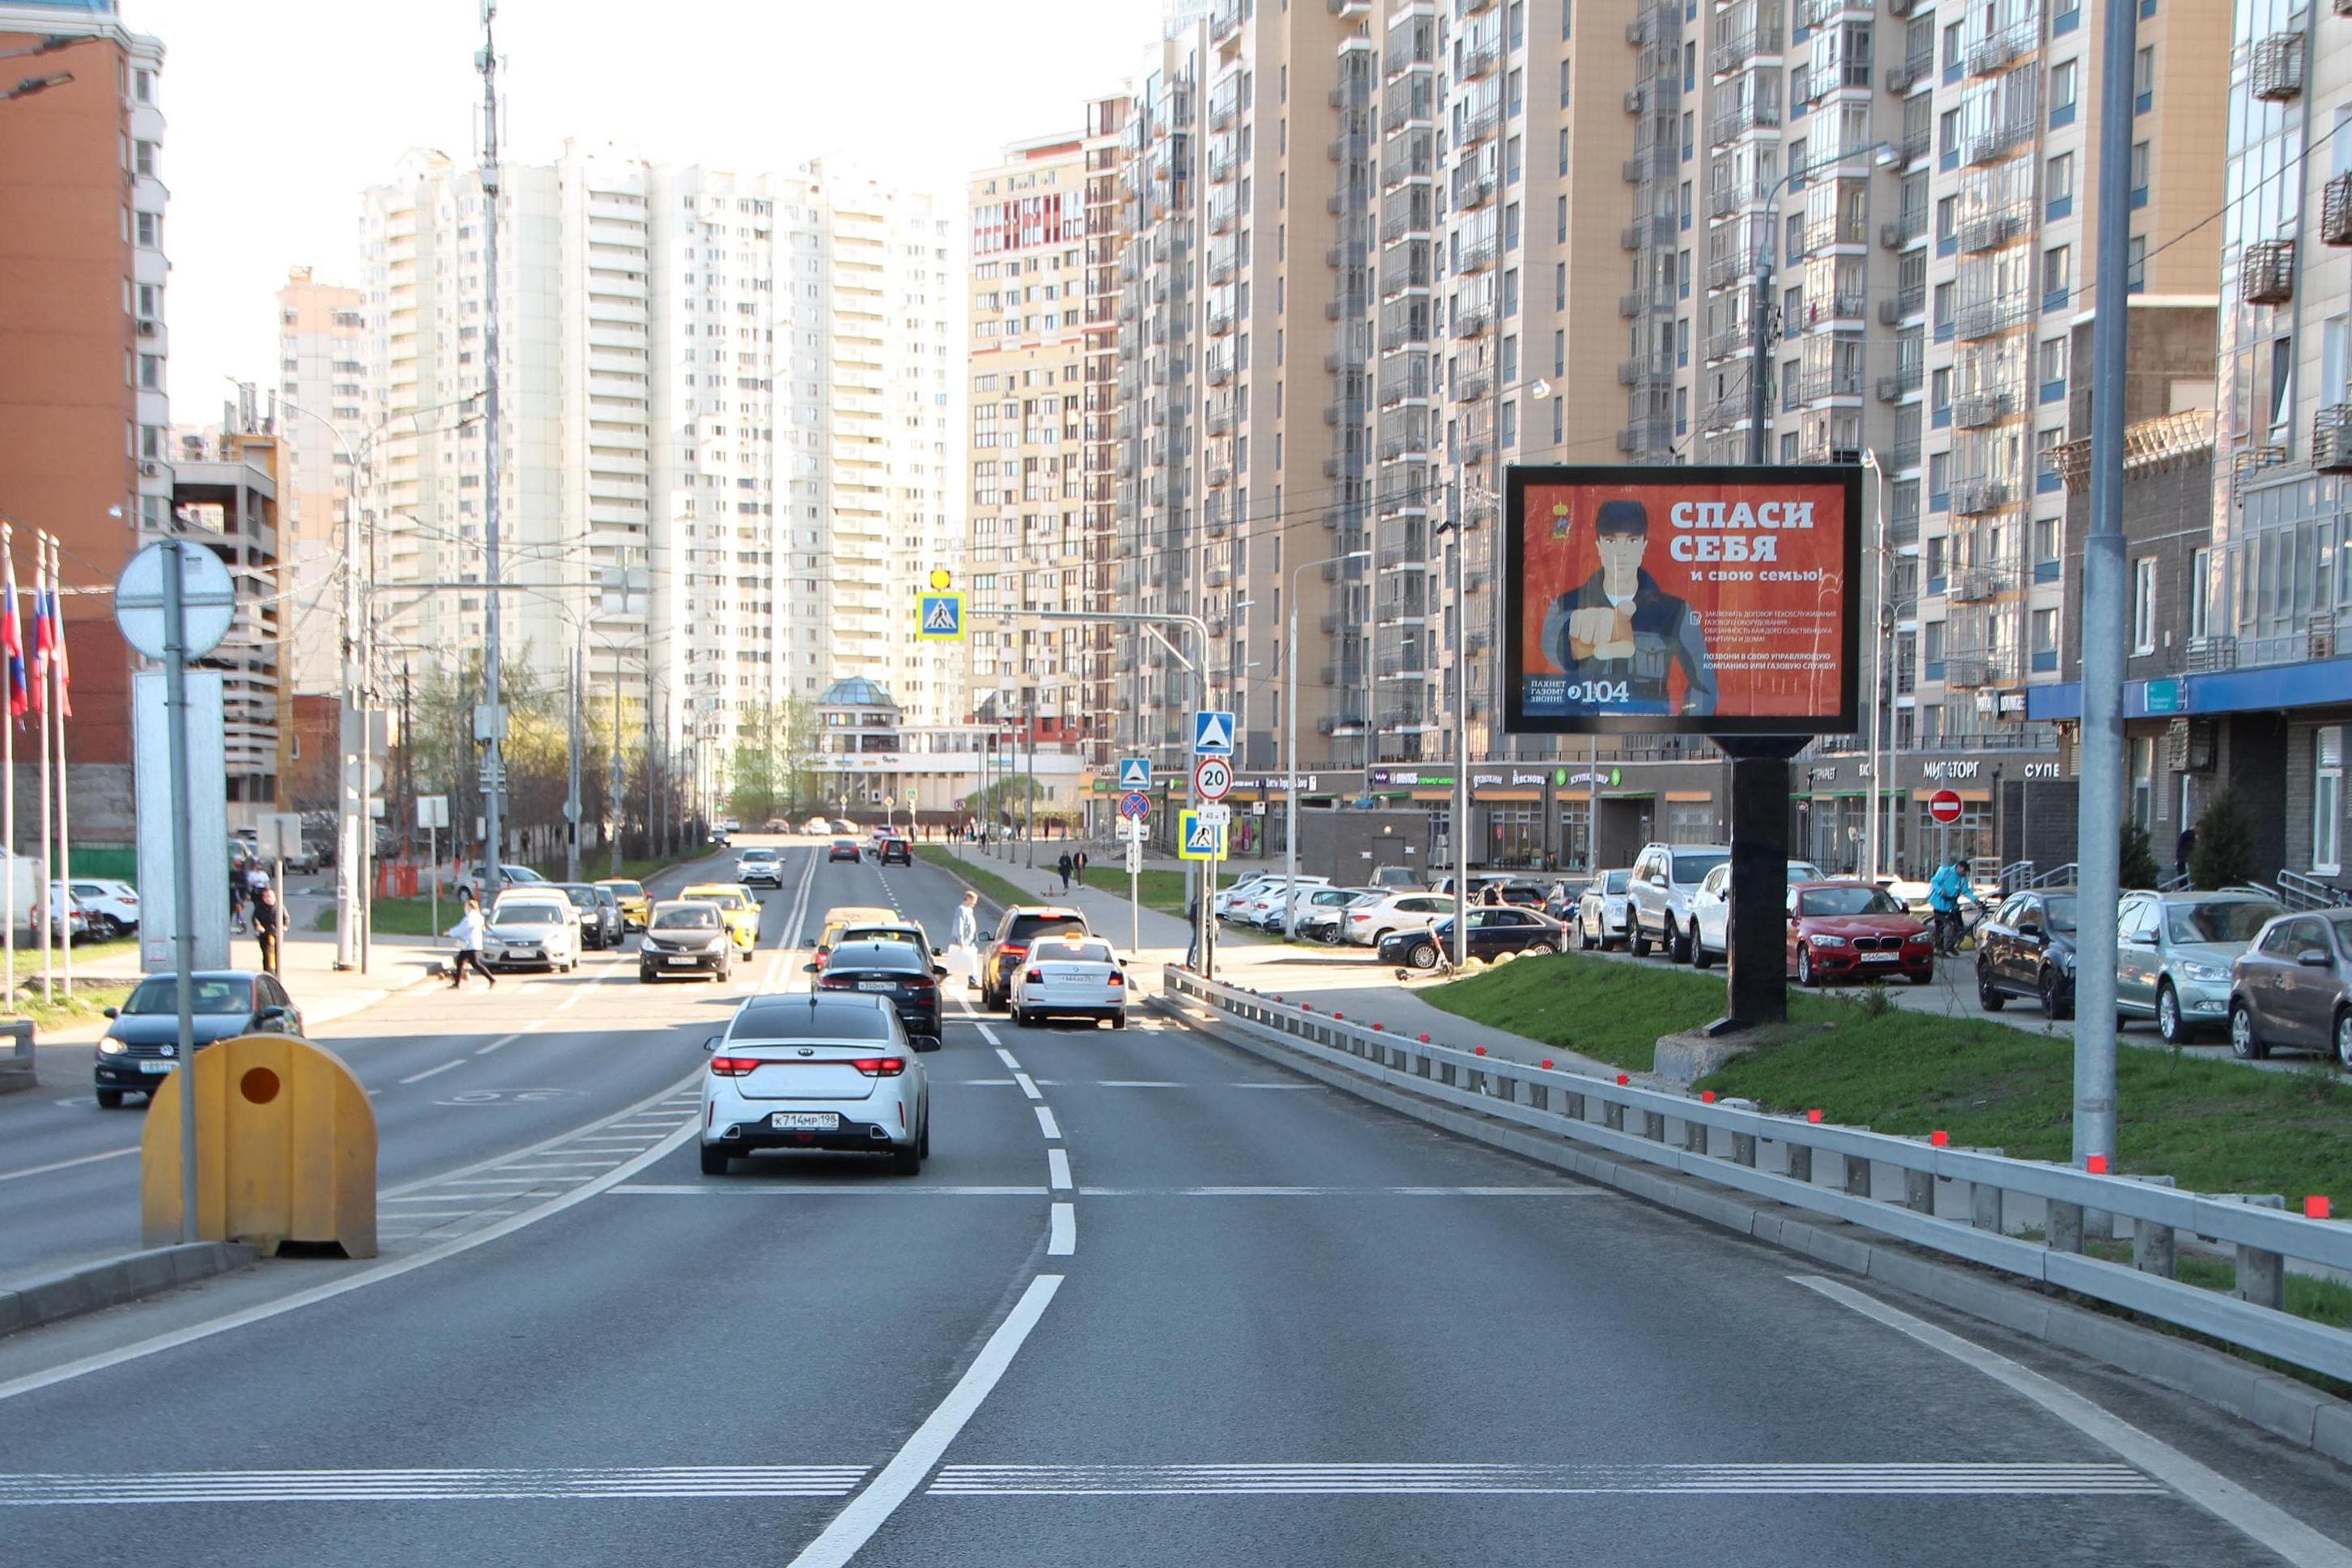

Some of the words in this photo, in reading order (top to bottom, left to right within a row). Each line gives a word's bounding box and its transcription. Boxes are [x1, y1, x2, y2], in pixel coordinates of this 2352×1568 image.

[1670, 501, 1814, 529] СПАСИ
[1669, 535, 1777, 562] СЕБЯ
[1691, 571, 1703, 581] и
[1708, 571, 1754, 581] свою
[1759, 567, 1822, 581] семью!
[1751, 627, 1781, 635] КАЖДОГО
[1771, 653, 1831, 661] УПРАВЛЯЮЩУЮ
[1703, 662, 1749, 670] КОМПАНИЮ
[1750, 662, 1767, 670] ИЛИ
[1767, 662, 1801, 670] ГАЗОВУЮ
[1802, 662, 1835, 670] СЛУЖБУ!
[1530, 680, 1567, 688] ПАХНЕТ
[1581, 680, 1630, 703] 104
[1530, 695, 1563, 703] ЗВОНИ!
[2024, 763, 2060, 778] СУПЕ
[1204, 770, 1224, 786] 20
[776, 1114, 818, 1126] К714МР
